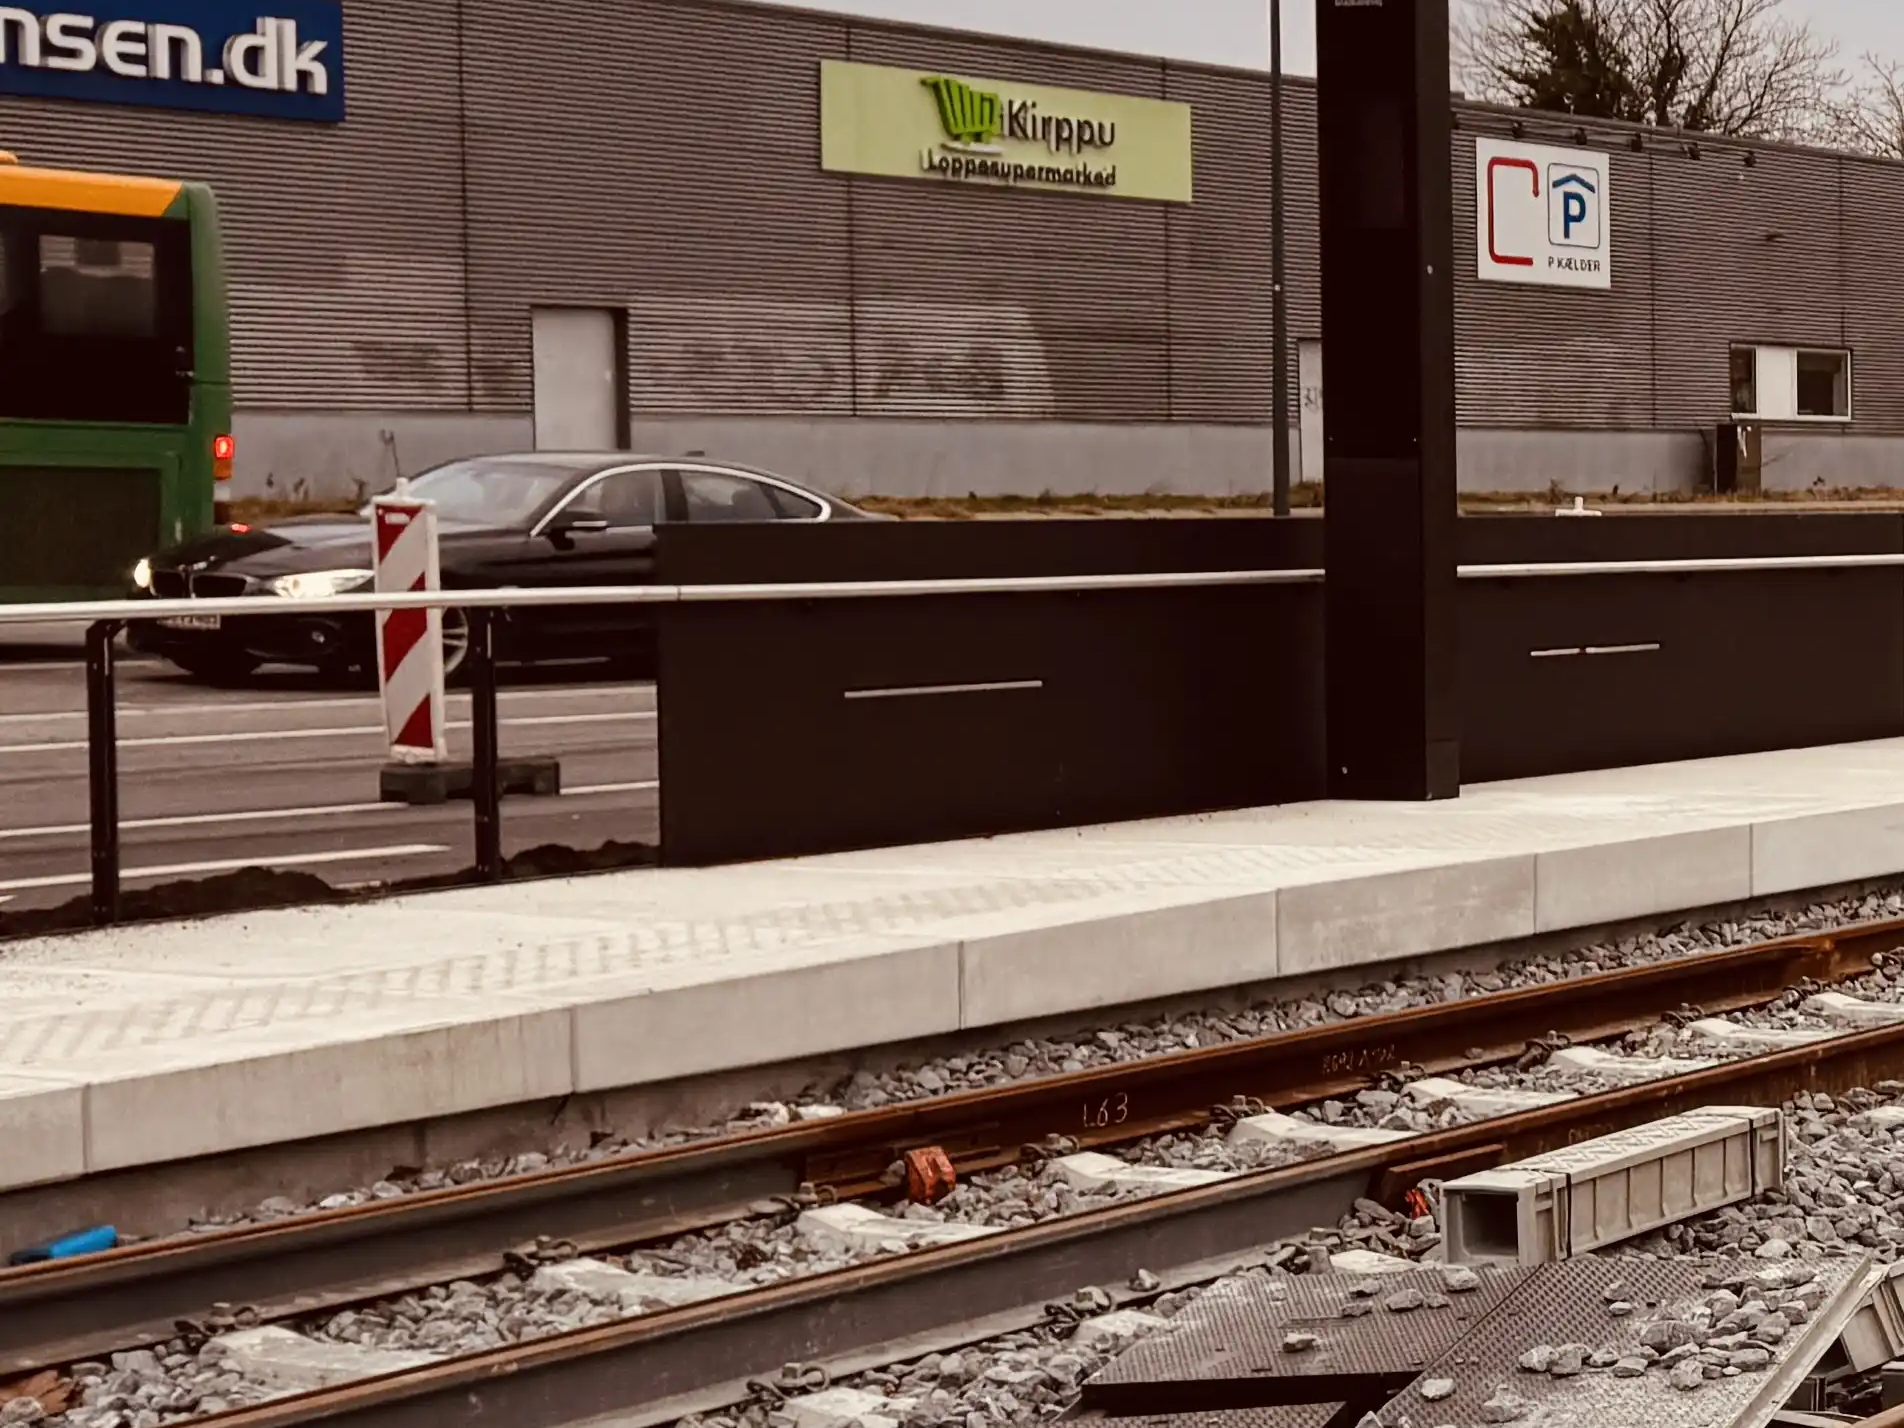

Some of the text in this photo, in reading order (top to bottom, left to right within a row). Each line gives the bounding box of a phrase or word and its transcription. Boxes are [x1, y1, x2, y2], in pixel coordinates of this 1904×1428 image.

[1008, 99, 1115, 154] Kirppu
[925, 147, 1116, 185] Loppesupermarked
[1563, 191, 1586, 239] P
